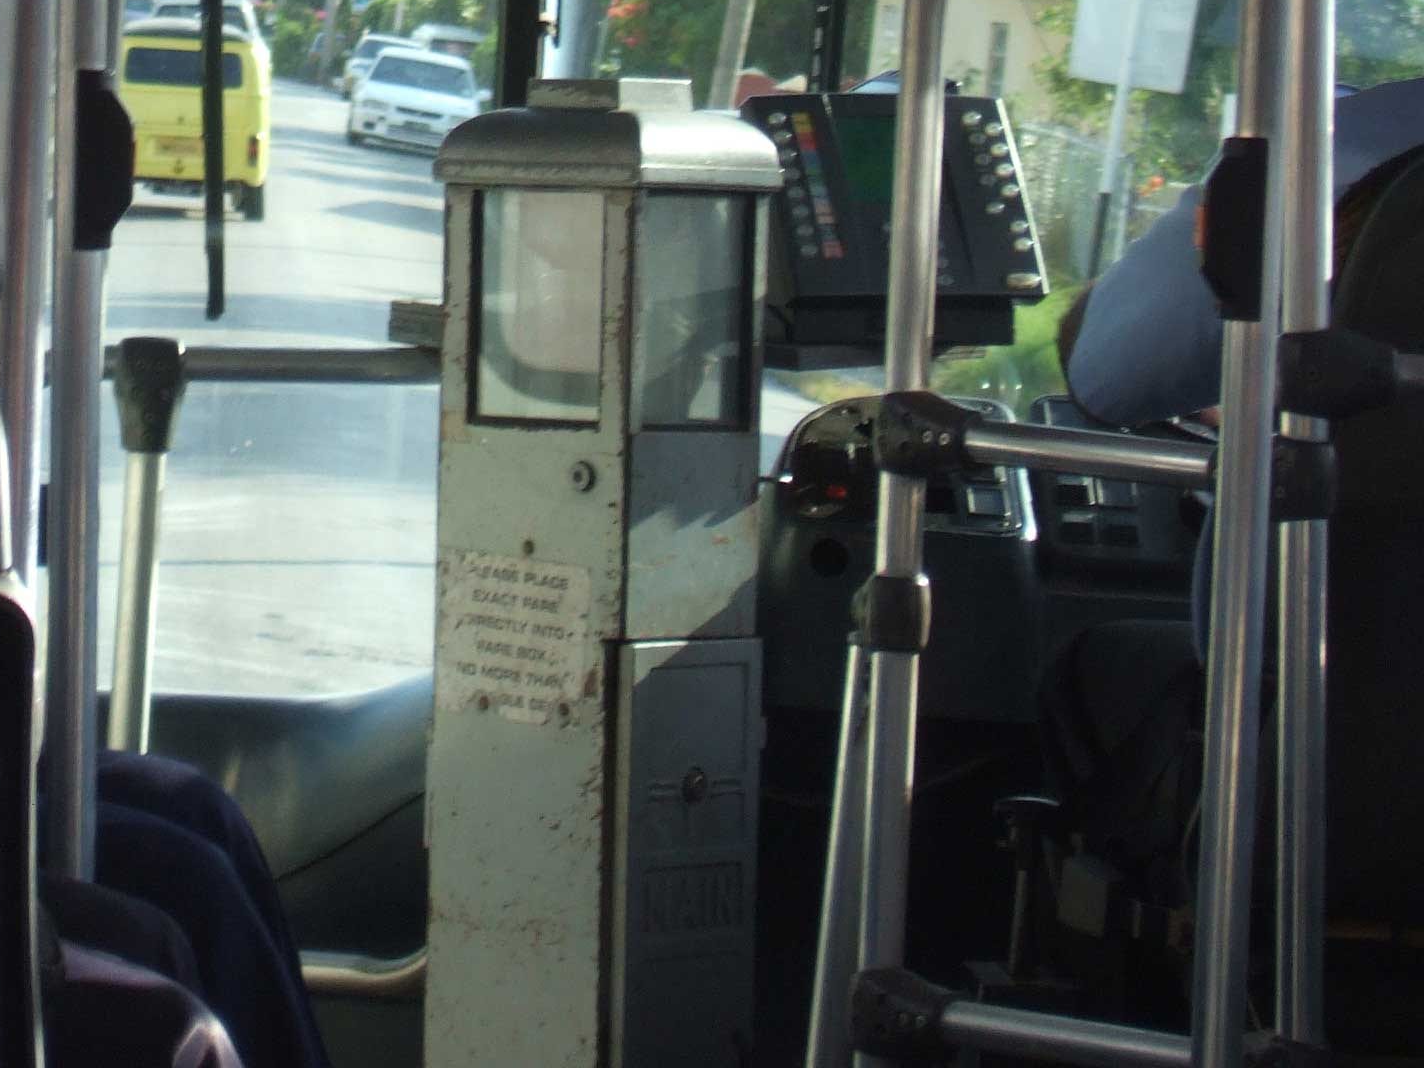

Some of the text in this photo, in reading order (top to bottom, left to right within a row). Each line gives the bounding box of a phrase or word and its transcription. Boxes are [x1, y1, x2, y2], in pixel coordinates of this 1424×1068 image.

[523, 570, 569, 591] PLACE
[471, 587, 560, 614] EXACT FARE
[531, 623, 565, 641] INTO
[476, 639, 513, 658] FARE
[456, 661, 477, 677] NO
[481, 663, 522, 684] MORE
